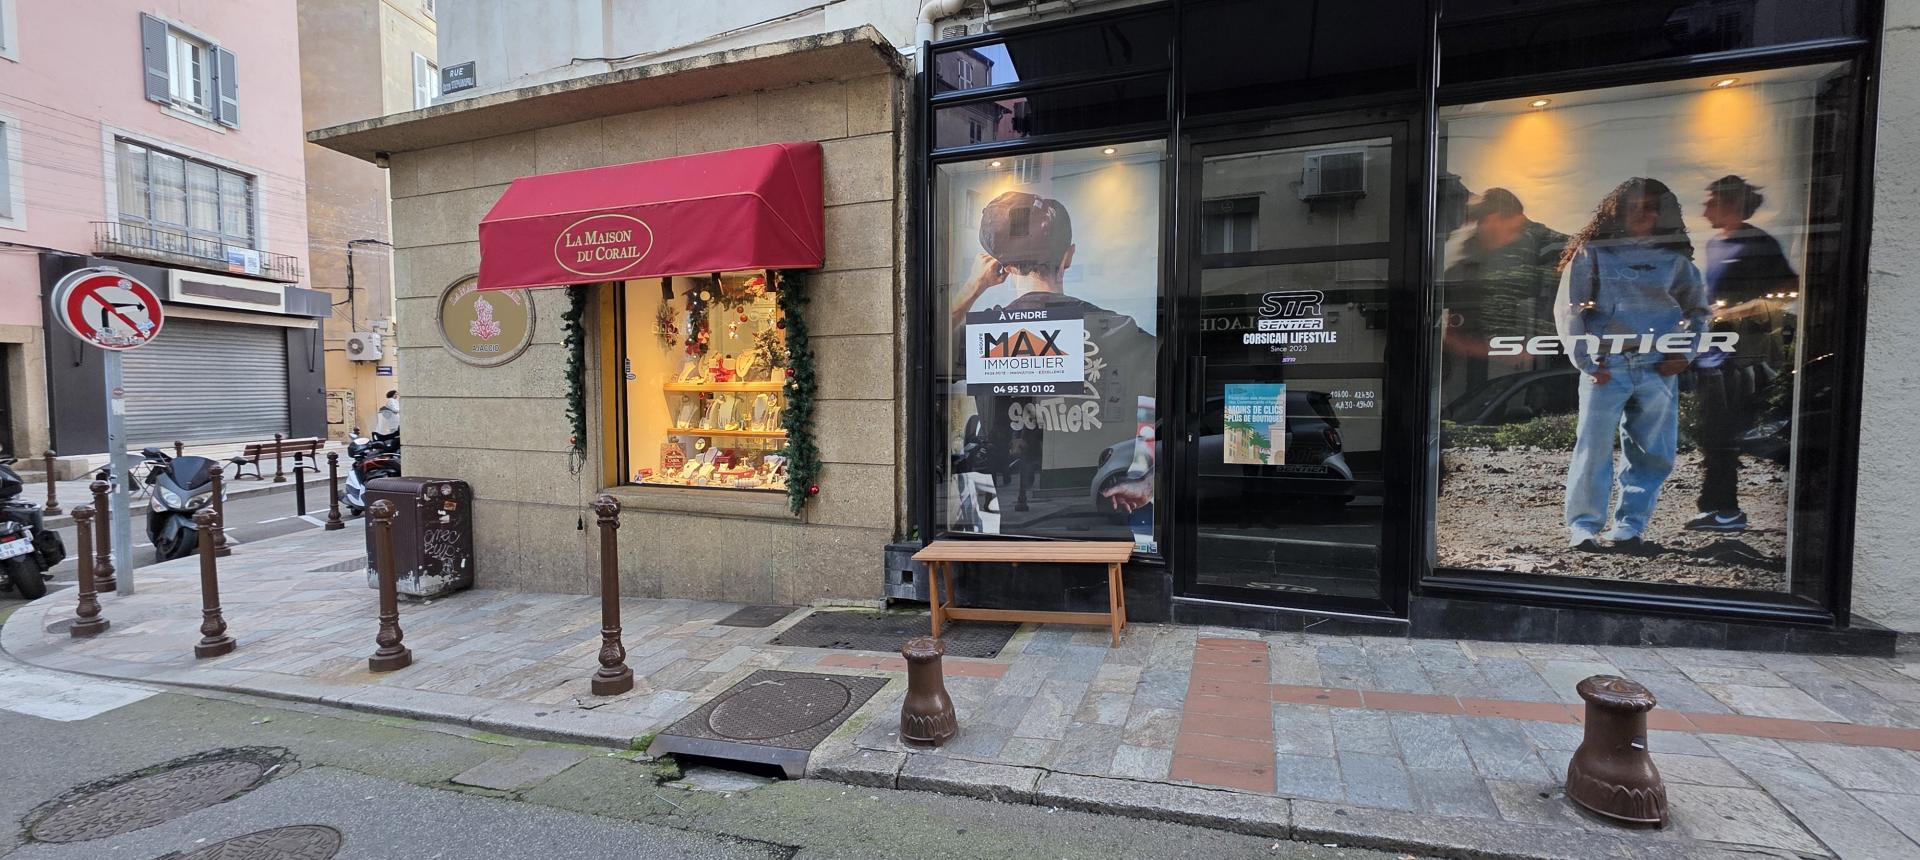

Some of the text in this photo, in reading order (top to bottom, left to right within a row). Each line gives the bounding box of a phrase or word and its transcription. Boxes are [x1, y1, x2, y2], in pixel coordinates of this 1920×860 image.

[450, 68, 464, 78] RUE
[565, 230, 632, 247] LA MAISON
[577, 246, 640, 262] DU CORAIL
[1258, 290, 1324, 317] STR
[998, 311, 1048, 320] À VENDRE
[1258, 319, 1323, 331] SENTIER
[984, 329, 1061, 358] MAX
[1243, 332, 1337, 345] CORSICAN LIFESTYLE
[1488, 332, 1740, 356] SENTIER
[1270, 345, 1288, 353] Since
[984, 357, 1064, 370] IMMOBILIER
[993, 386, 1006, 394] 04
[1020, 385, 1030, 393] 21
[1031, 385, 1042, 393] 01
[1043, 385, 1056, 393] 02
[1228, 405, 1284, 415] MOINS DE CLICS
[1253, 415, 1284, 423] BOUTIQUES
